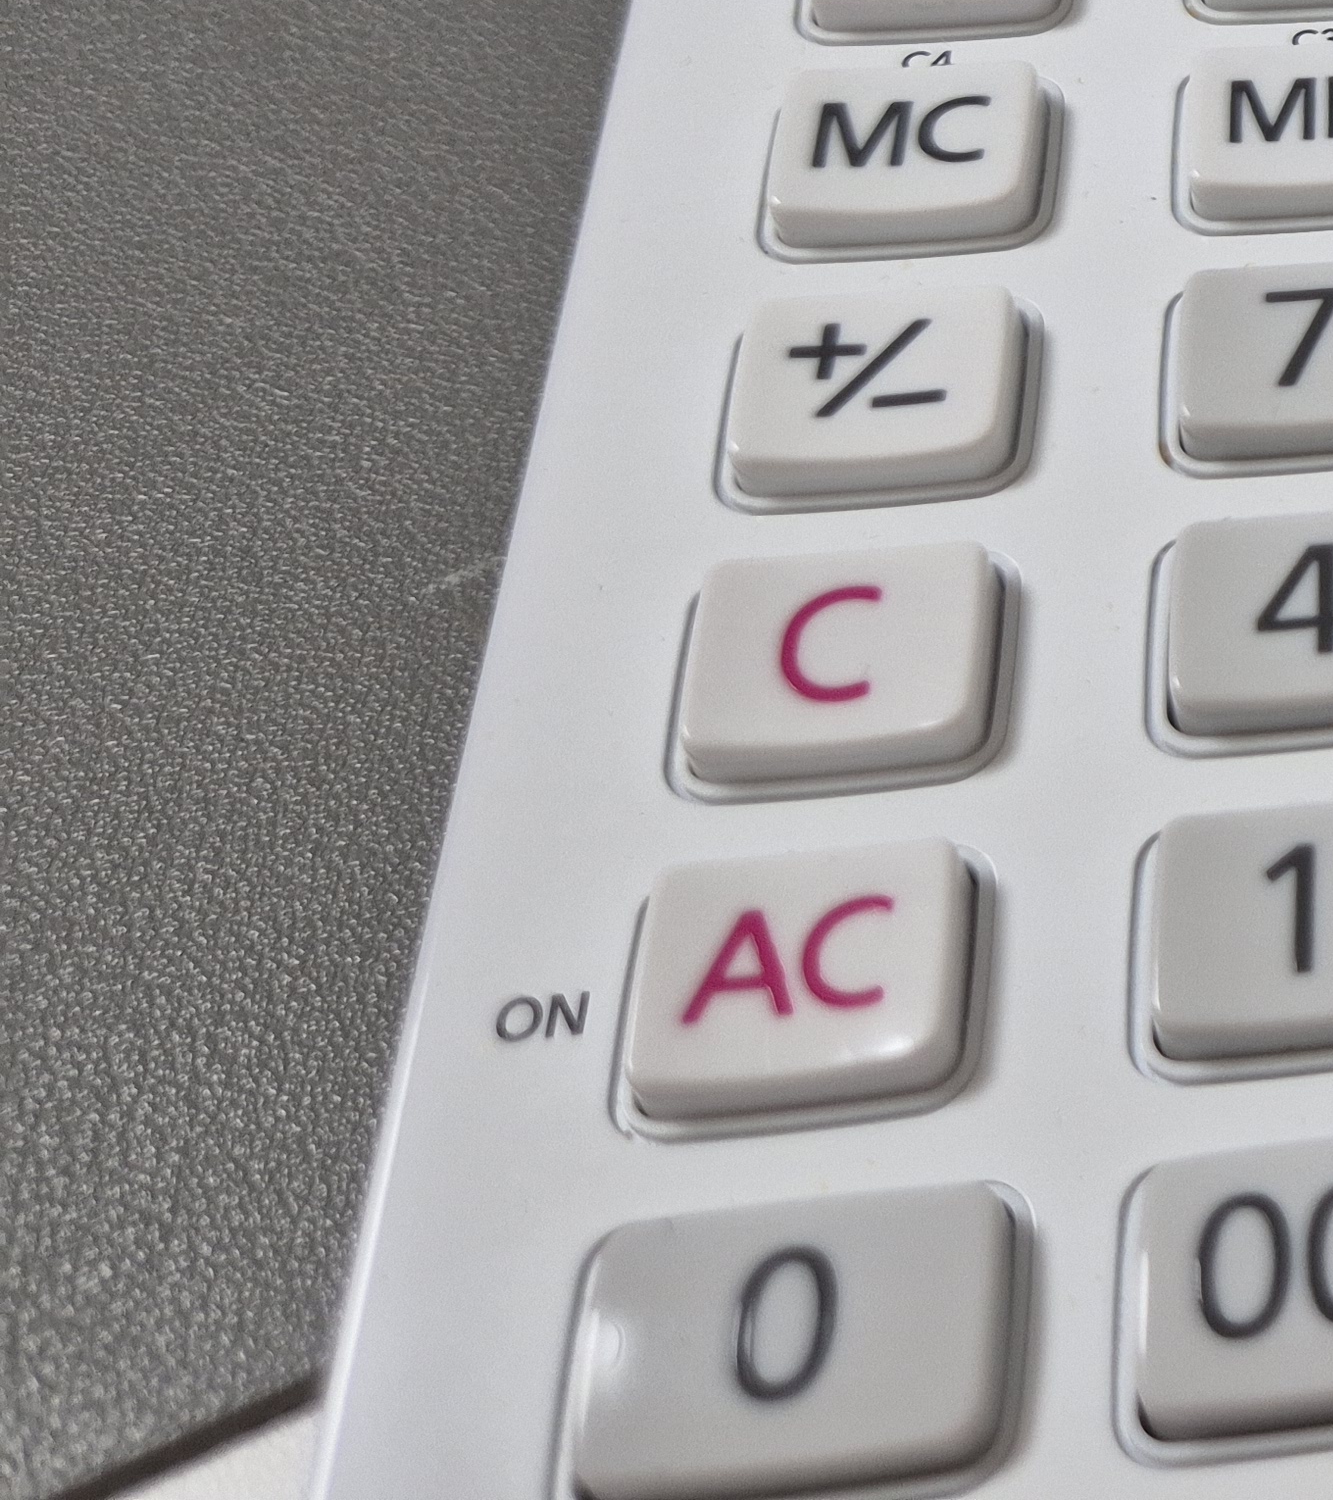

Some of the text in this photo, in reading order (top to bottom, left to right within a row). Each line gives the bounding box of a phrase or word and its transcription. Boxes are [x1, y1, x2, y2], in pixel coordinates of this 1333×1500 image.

[809, 94, 991, 169] MC
[777, 584, 883, 705] C
[679, 894, 894, 1027] AC
[1264, 843, 1316, 975] 1
[494, 991, 590, 1043] ON
[730, 1245, 839, 1406] 0
